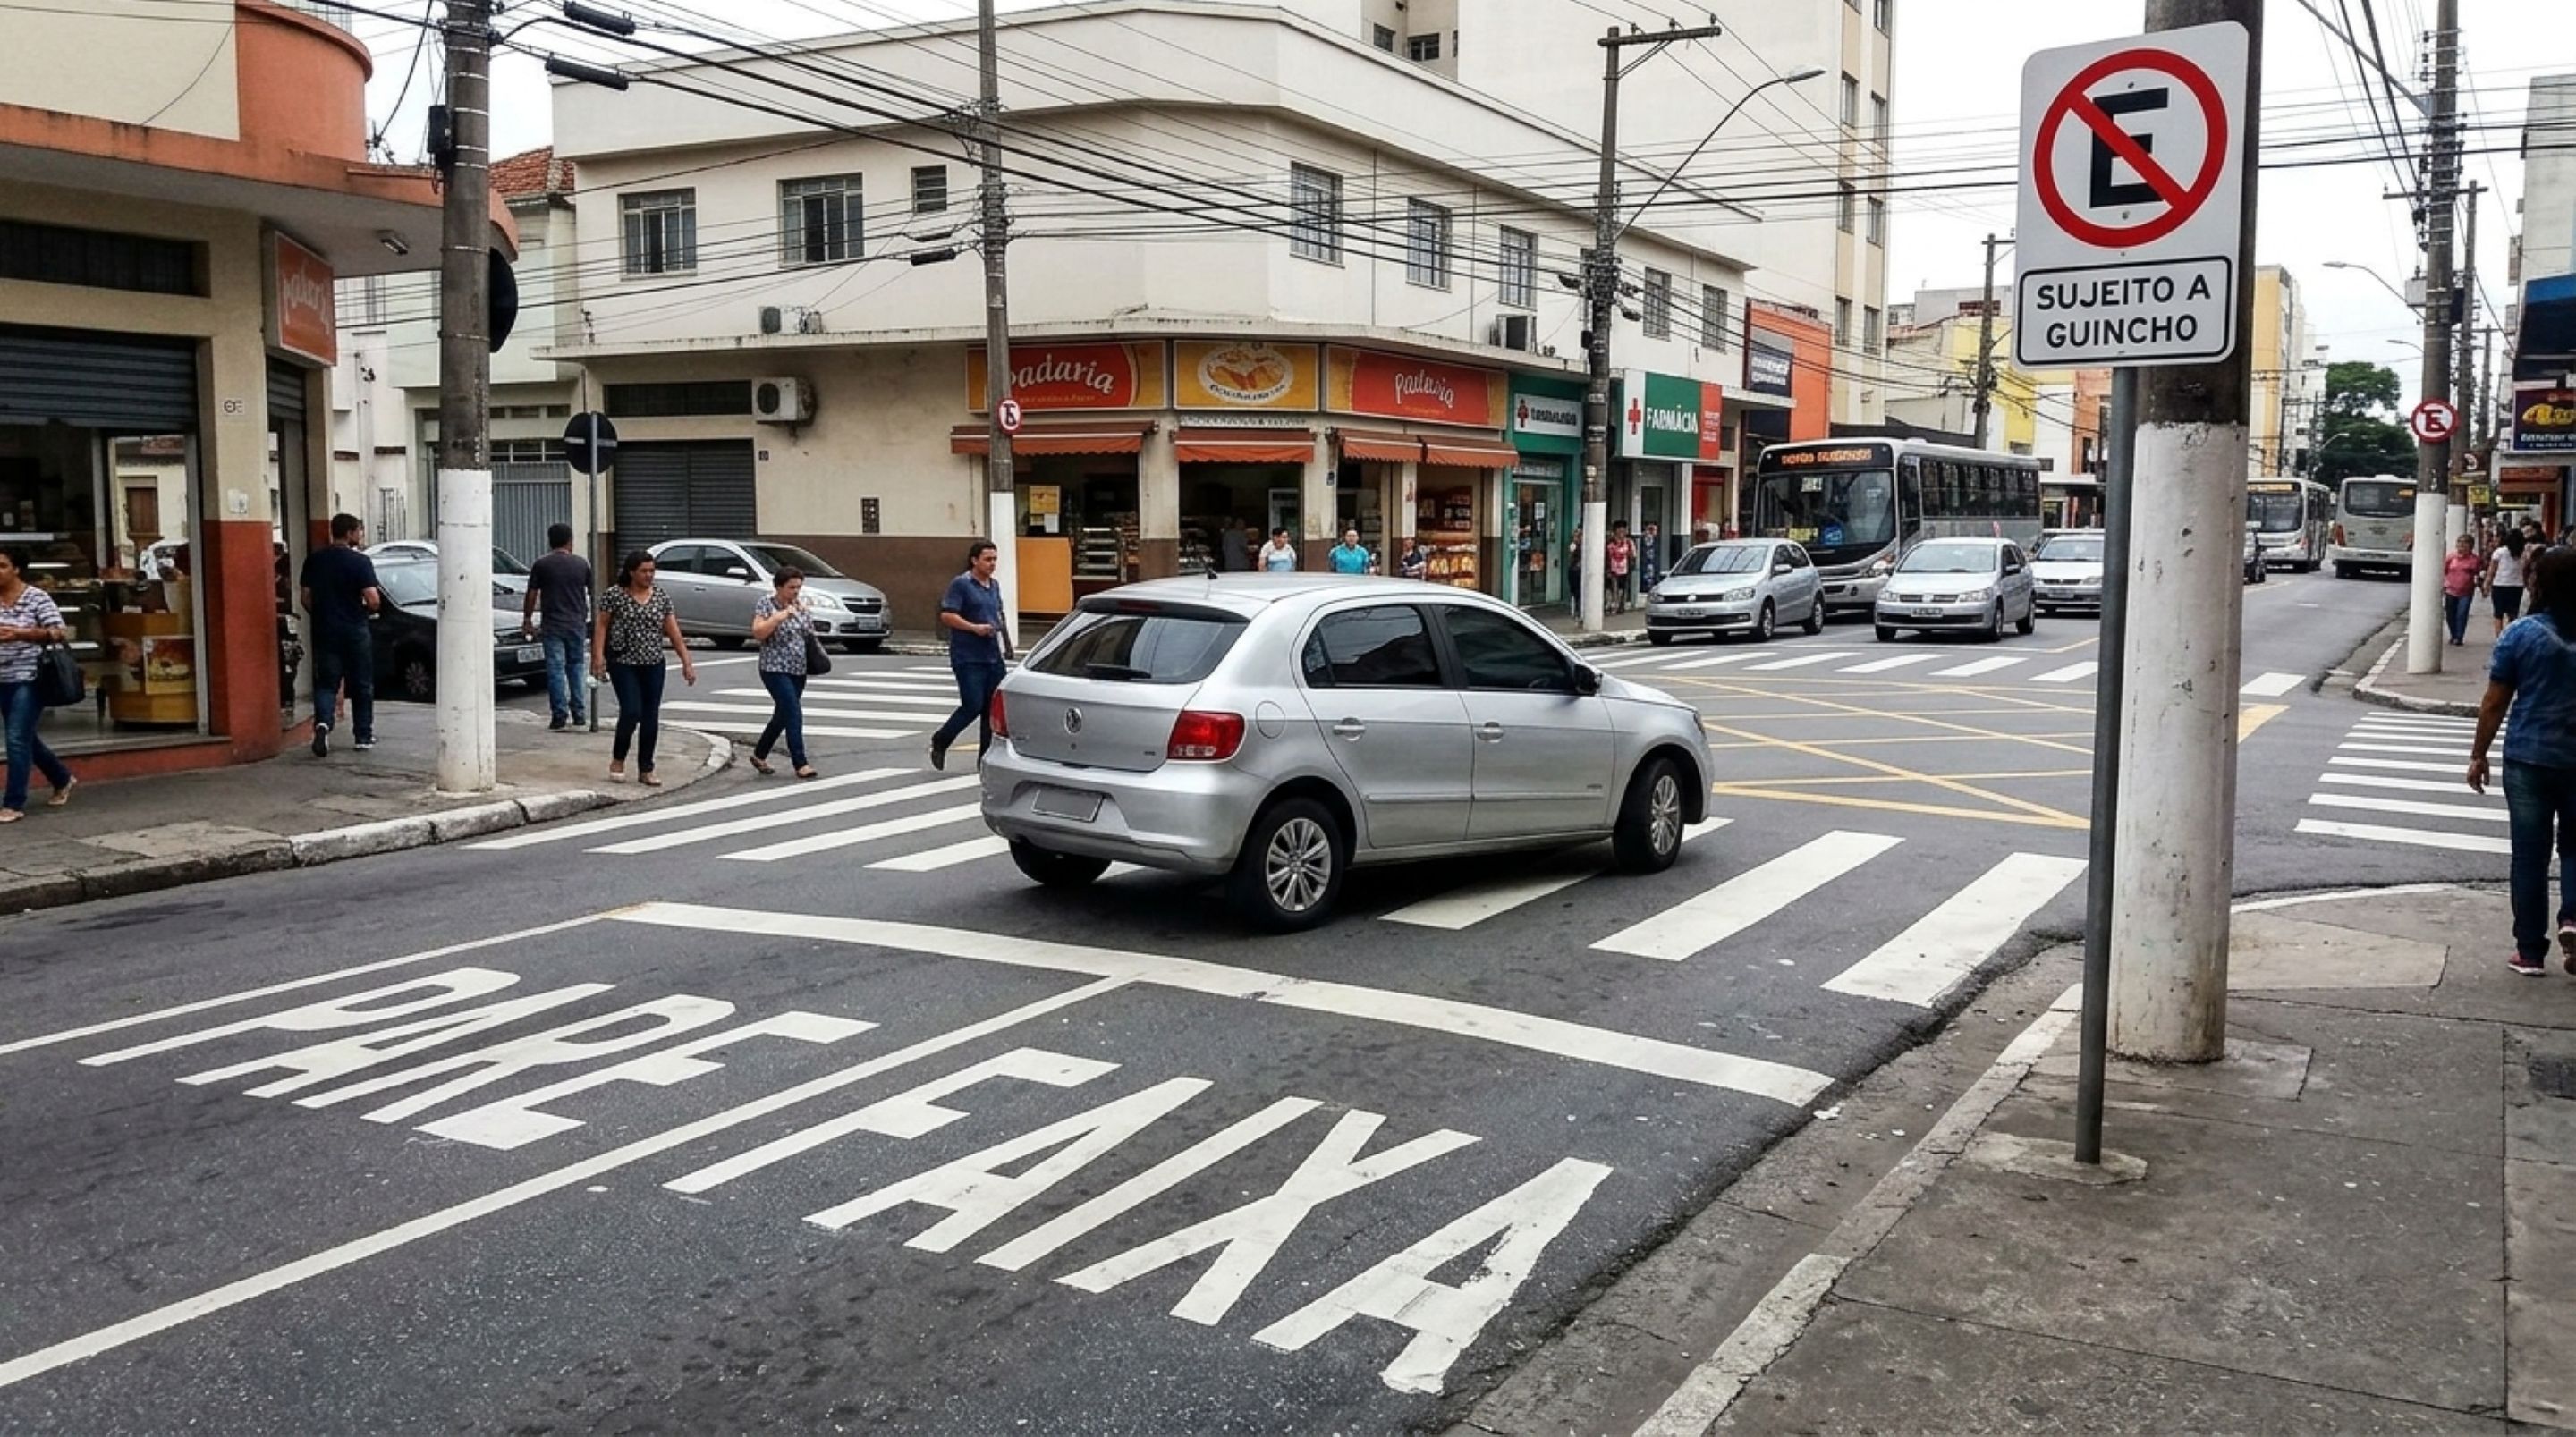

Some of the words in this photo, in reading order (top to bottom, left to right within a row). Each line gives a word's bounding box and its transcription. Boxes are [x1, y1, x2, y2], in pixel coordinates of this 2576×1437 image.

[2089, 87, 2169, 209] E
[2036, 275, 2174, 311] SUJEITO
[2185, 274, 2211, 300] A
[2046, 313, 2198, 349] GUINCHO
[75, 967, 882, 1150] PARE
[662, 1047, 1614, 1394] FAIXA
